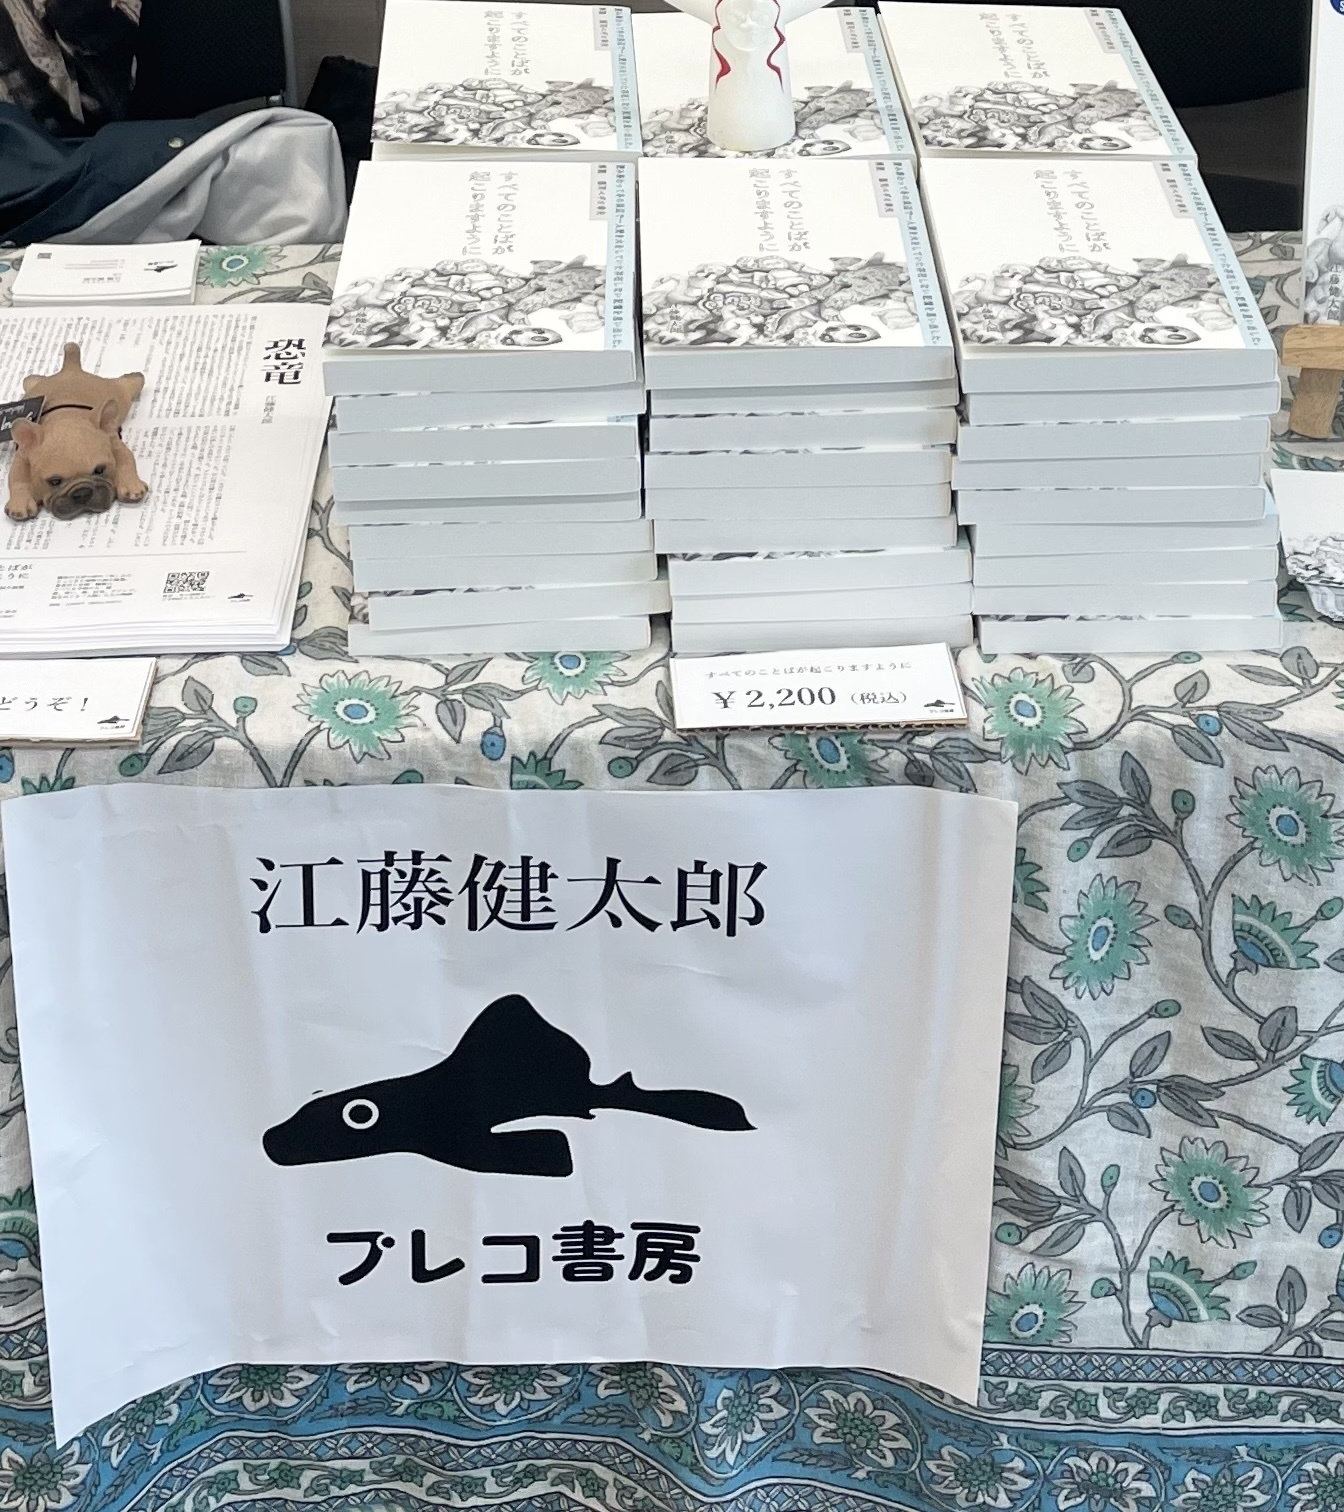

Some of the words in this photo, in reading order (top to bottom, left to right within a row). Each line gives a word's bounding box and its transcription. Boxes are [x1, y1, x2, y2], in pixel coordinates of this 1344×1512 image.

[260, 338, 306, 385] 恐竜
[249, 850, 766, 938] 江藤健太郎
[326, 1219, 701, 1286] プレコ書房
